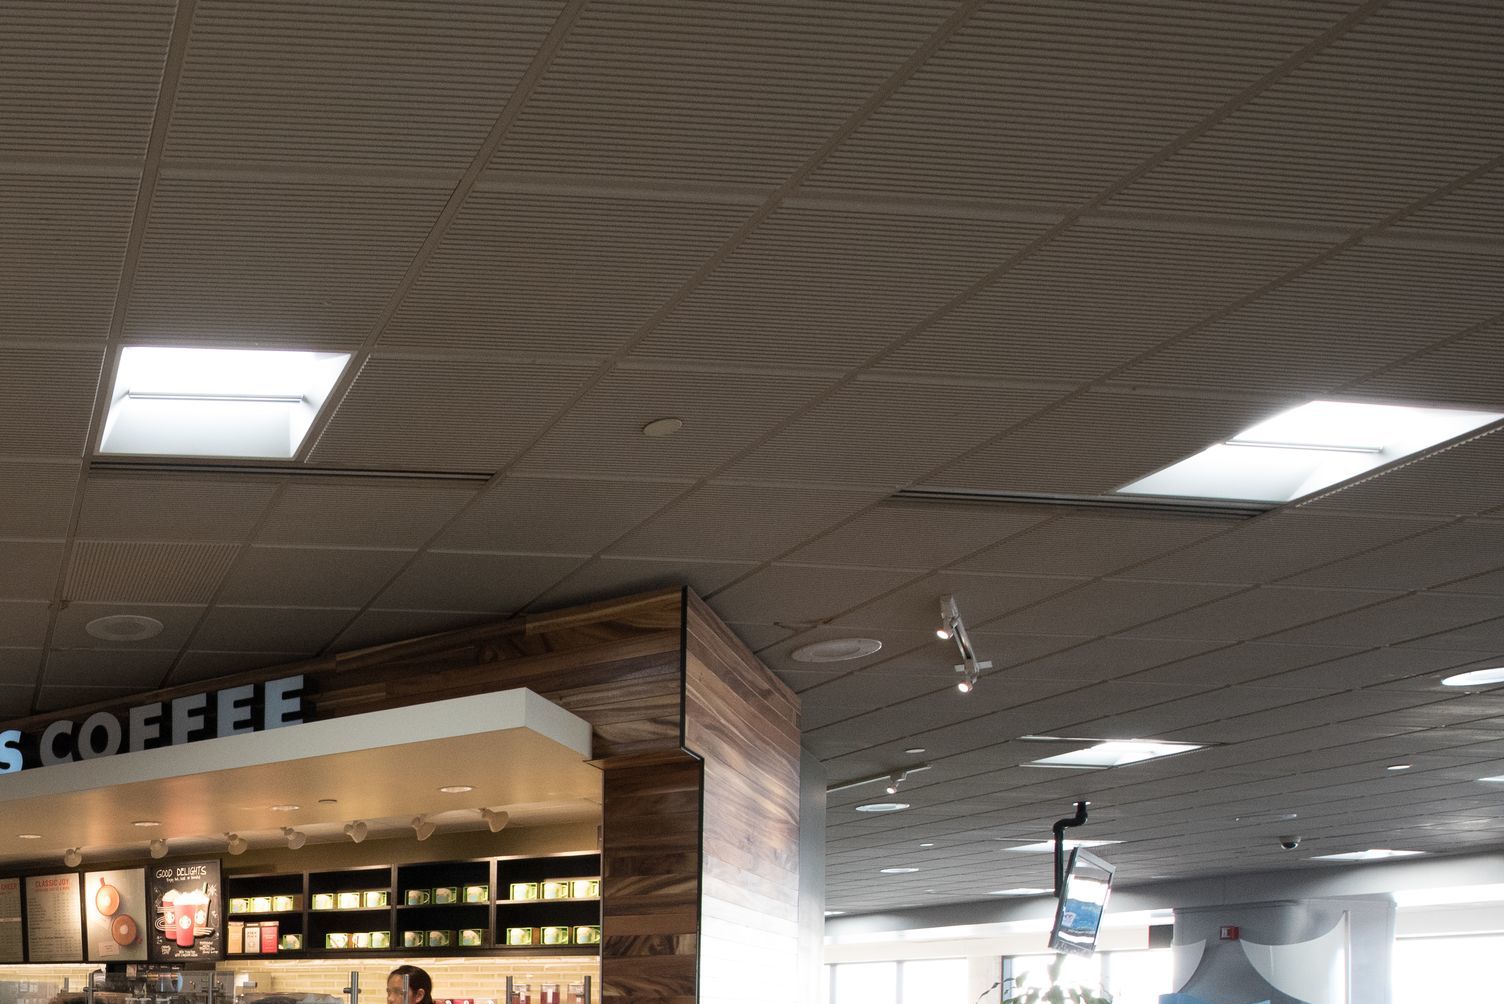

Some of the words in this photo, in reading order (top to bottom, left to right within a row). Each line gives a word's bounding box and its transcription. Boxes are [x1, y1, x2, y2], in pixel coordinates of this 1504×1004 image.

[39, 674, 304, 768] COFFEE
[156, 869, 173, 879] GOOD
[176, 866, 207, 877] DELIGHTS
